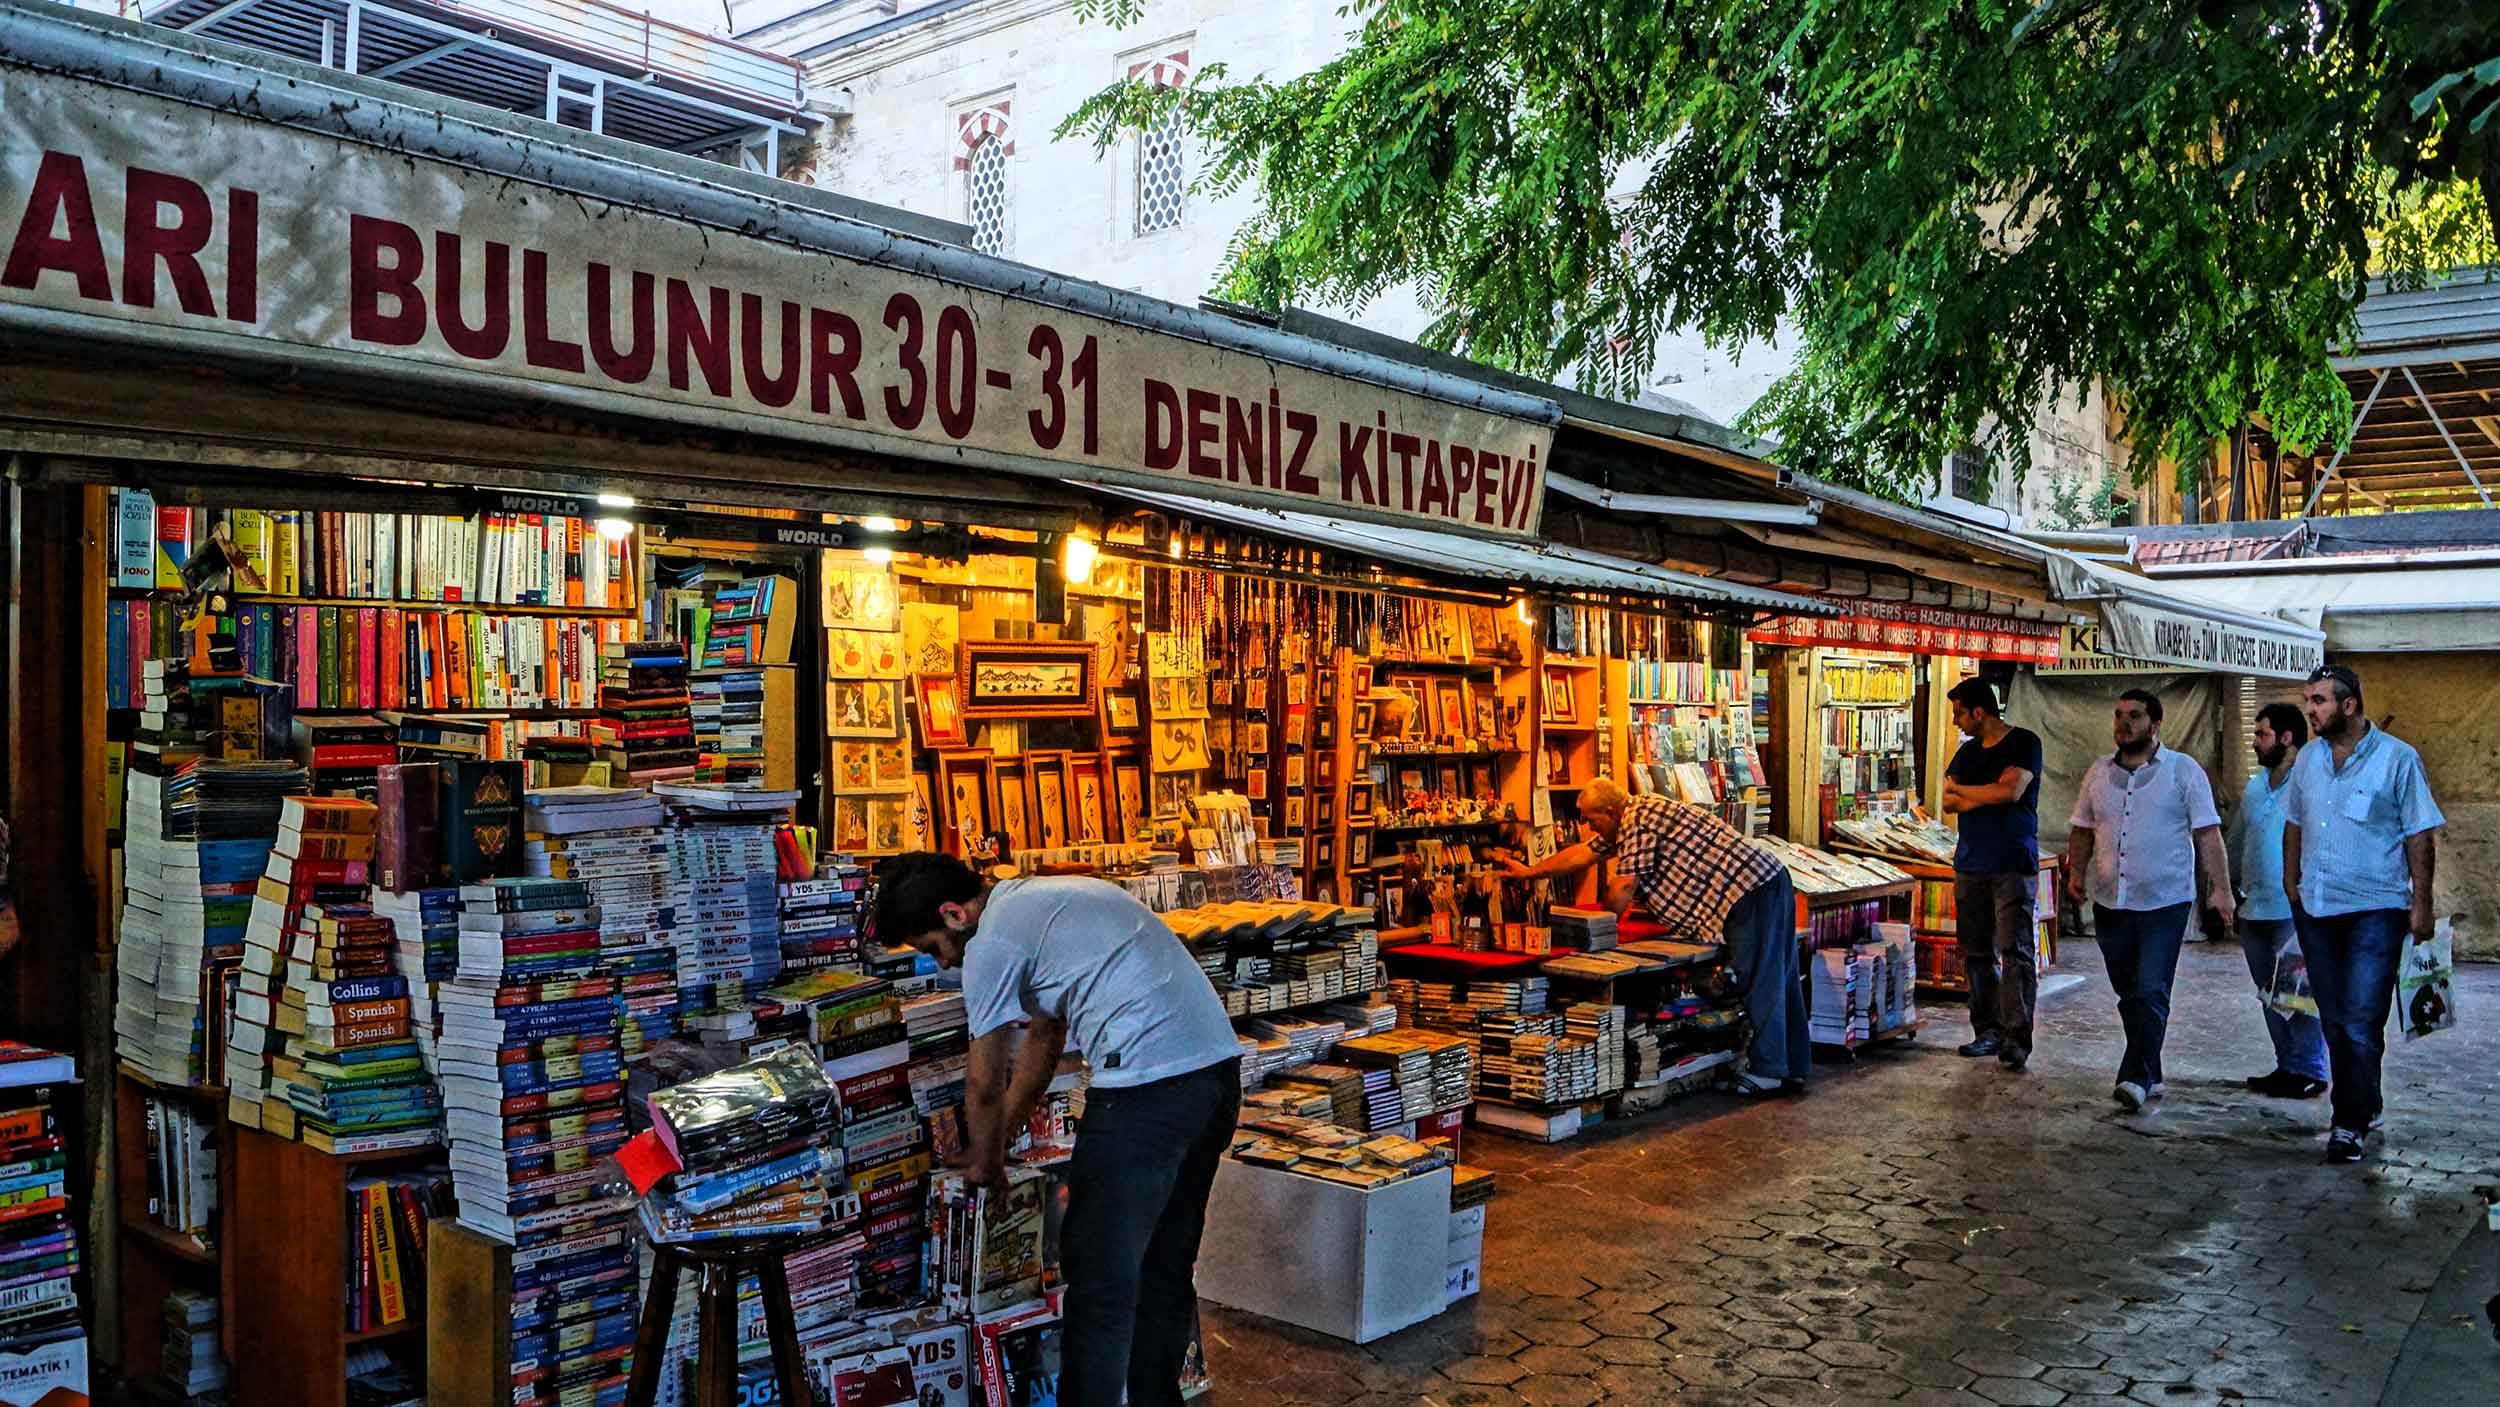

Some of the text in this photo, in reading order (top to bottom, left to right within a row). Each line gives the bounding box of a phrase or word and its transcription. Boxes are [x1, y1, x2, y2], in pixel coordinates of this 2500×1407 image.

[1, 149, 259, 325] ARI
[350, 213, 867, 422] BULUNUR
[1144, 377, 1320, 496] DENİZ
[1339, 410, 1538, 531] KİTAPEVİ
[501, 495, 580, 515] WORLD
[777, 528, 843, 546] WORLD
[1871, 601, 1901, 621] DERS
[1904, 610, 1917, 622] ve
[2202, 621, 2218, 662] TÜM
[520, 660, 528, 680] JAVA
[795, 884, 813, 894] YDS
[786, 955, 832, 969] WORD POWER
[333, 982, 380, 999] Collins
[348, 1003, 396, 1019] Spanish
[348, 1023, 396, 1041] Spanish
[907, 1338, 956, 1366] YDS
[0, 1361, 61, 1382] TEMATİK
